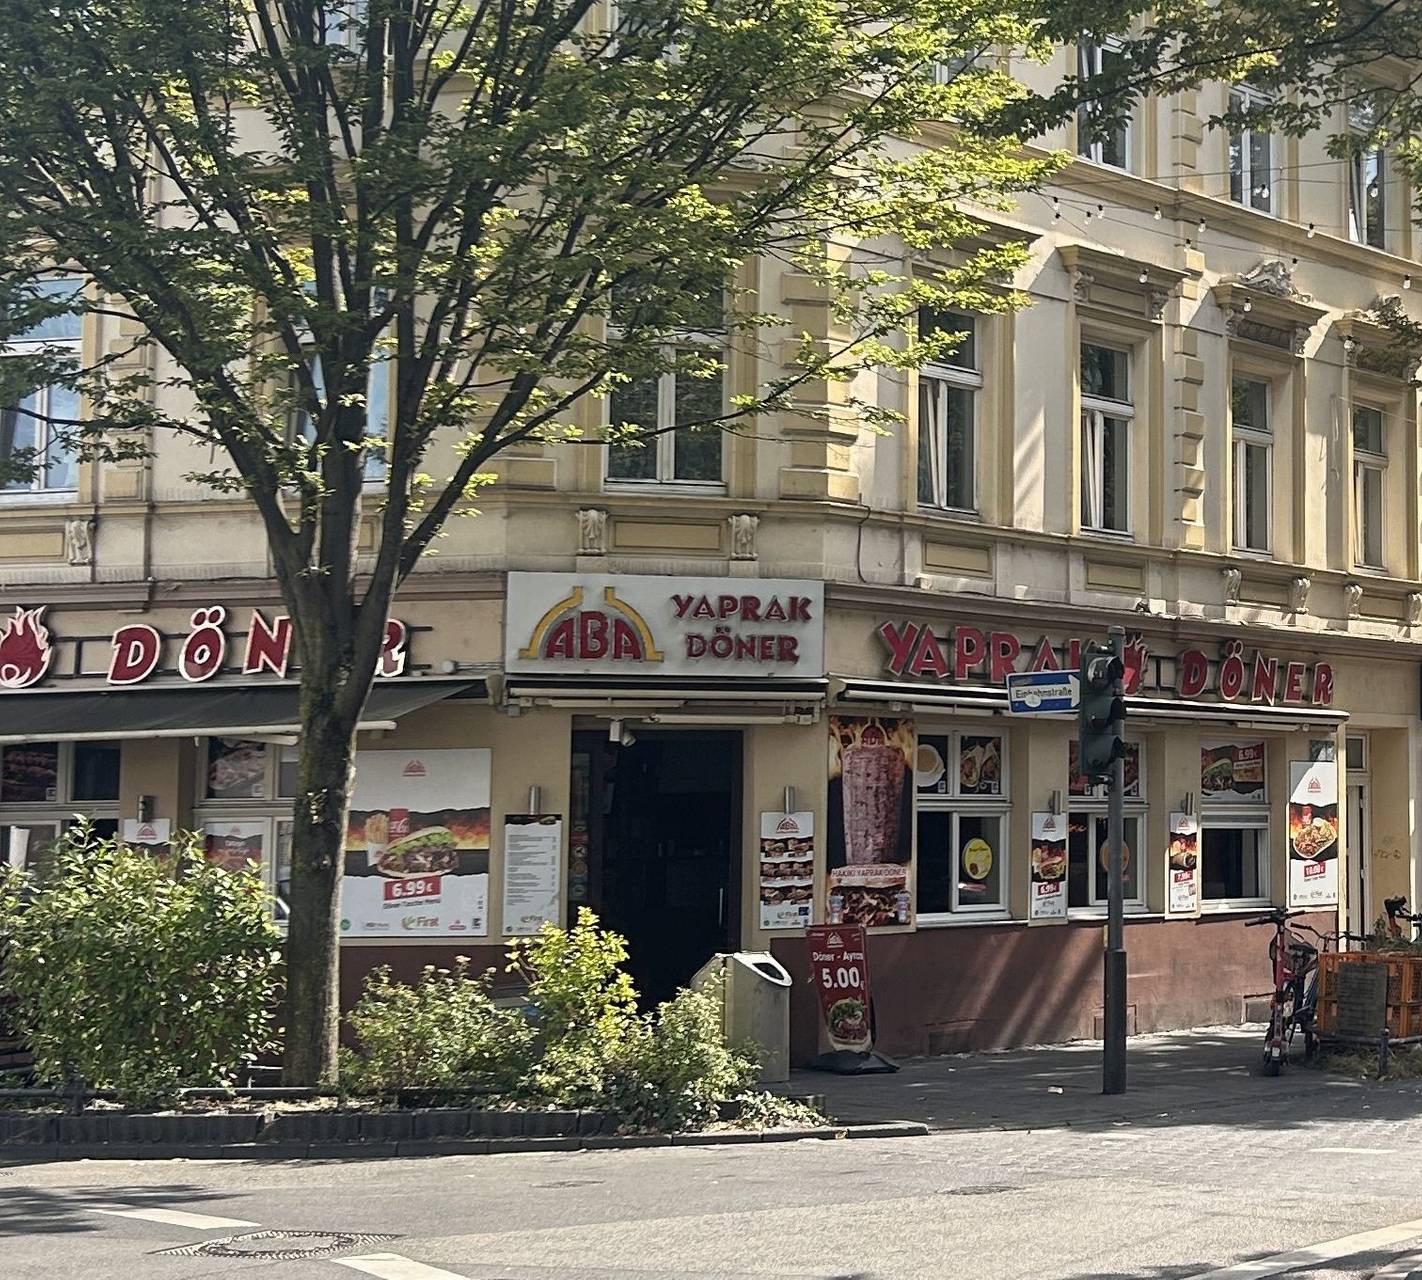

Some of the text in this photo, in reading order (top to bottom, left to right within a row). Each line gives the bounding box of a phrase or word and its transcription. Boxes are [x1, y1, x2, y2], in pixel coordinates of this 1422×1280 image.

[671, 594, 814, 623] YAPRAK
[106, 605, 407, 685] DÖNR
[545, 610, 642, 660] ABA
[685, 626, 801, 664] DÖNER
[1180, 639, 1335, 706] DÖNER
